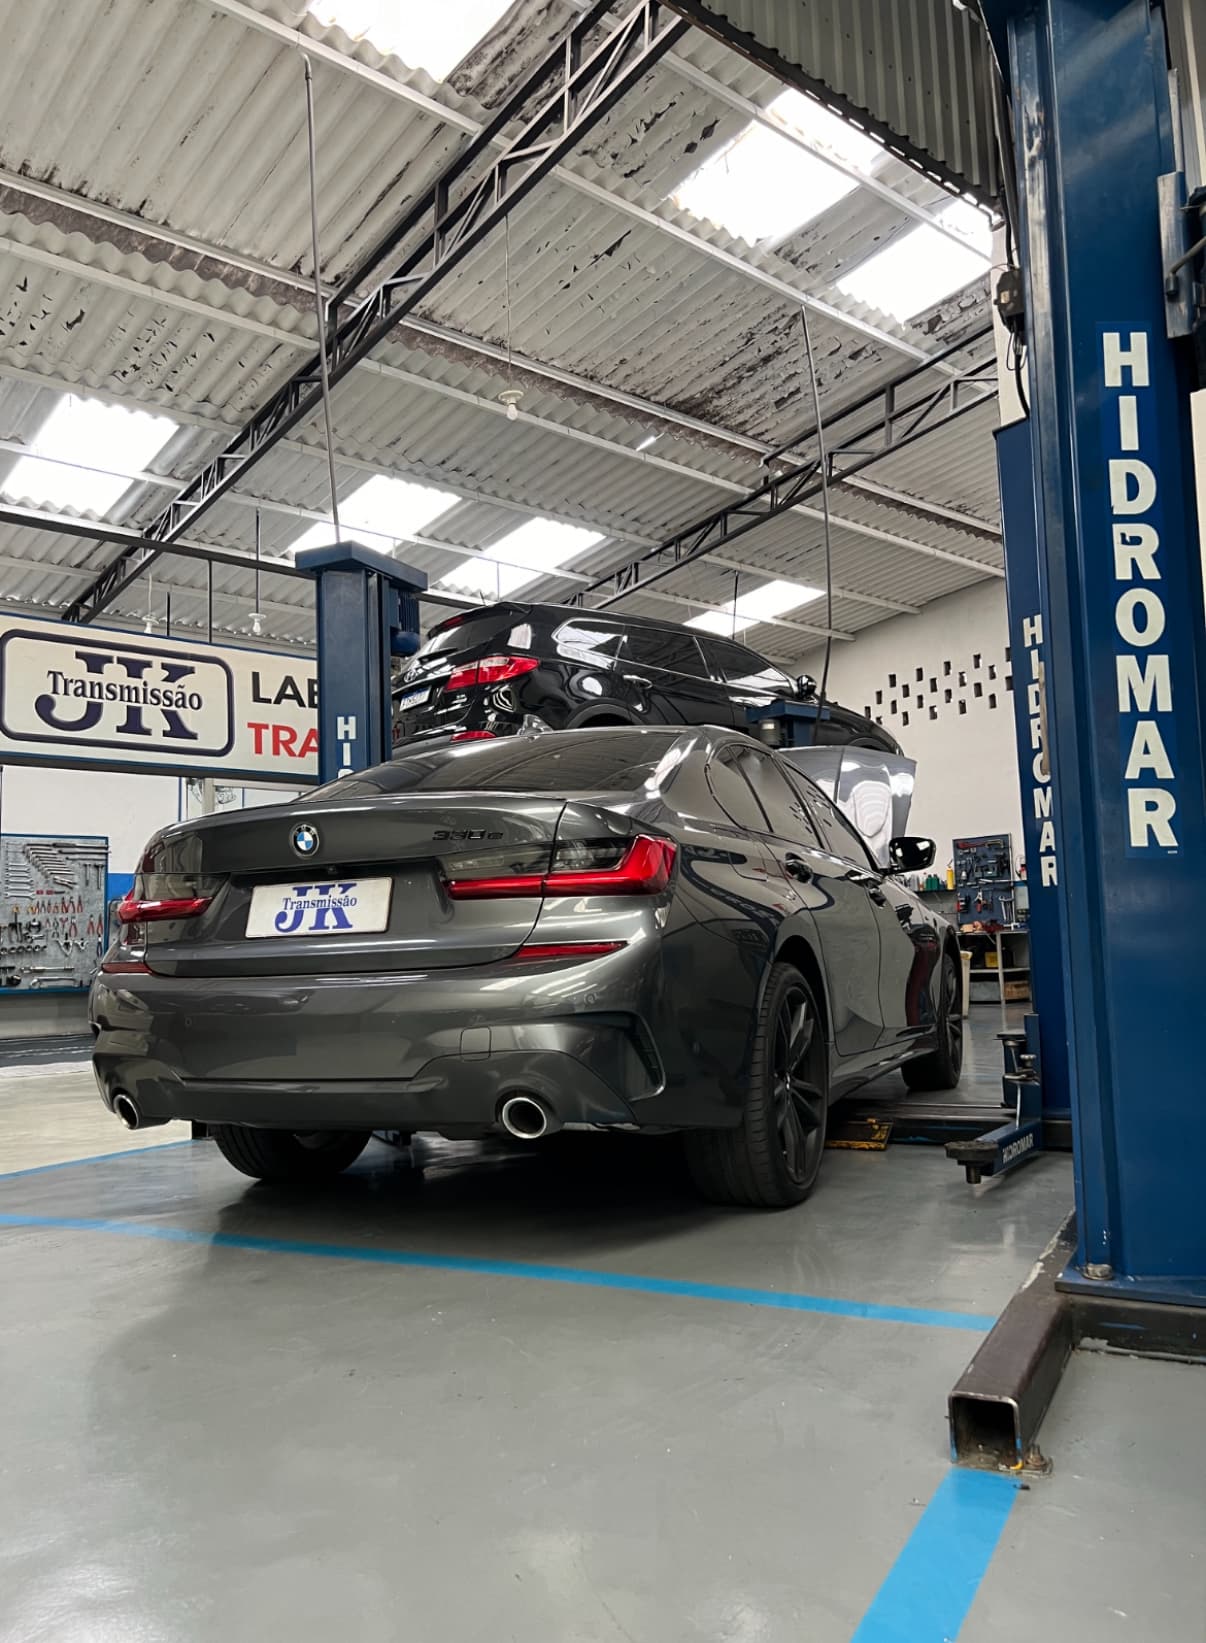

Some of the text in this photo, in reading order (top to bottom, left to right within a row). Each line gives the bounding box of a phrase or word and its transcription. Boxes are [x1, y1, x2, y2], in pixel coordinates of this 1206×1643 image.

[1102, 331, 1179, 847] HIDROMAR
[35, 651, 198, 740] JK
[47, 670, 203, 711] Transmissão
[1022, 614, 1058, 887] HIDROMAR
[274, 883, 357, 933] JK
[282, 895, 357, 911] Transmissão
